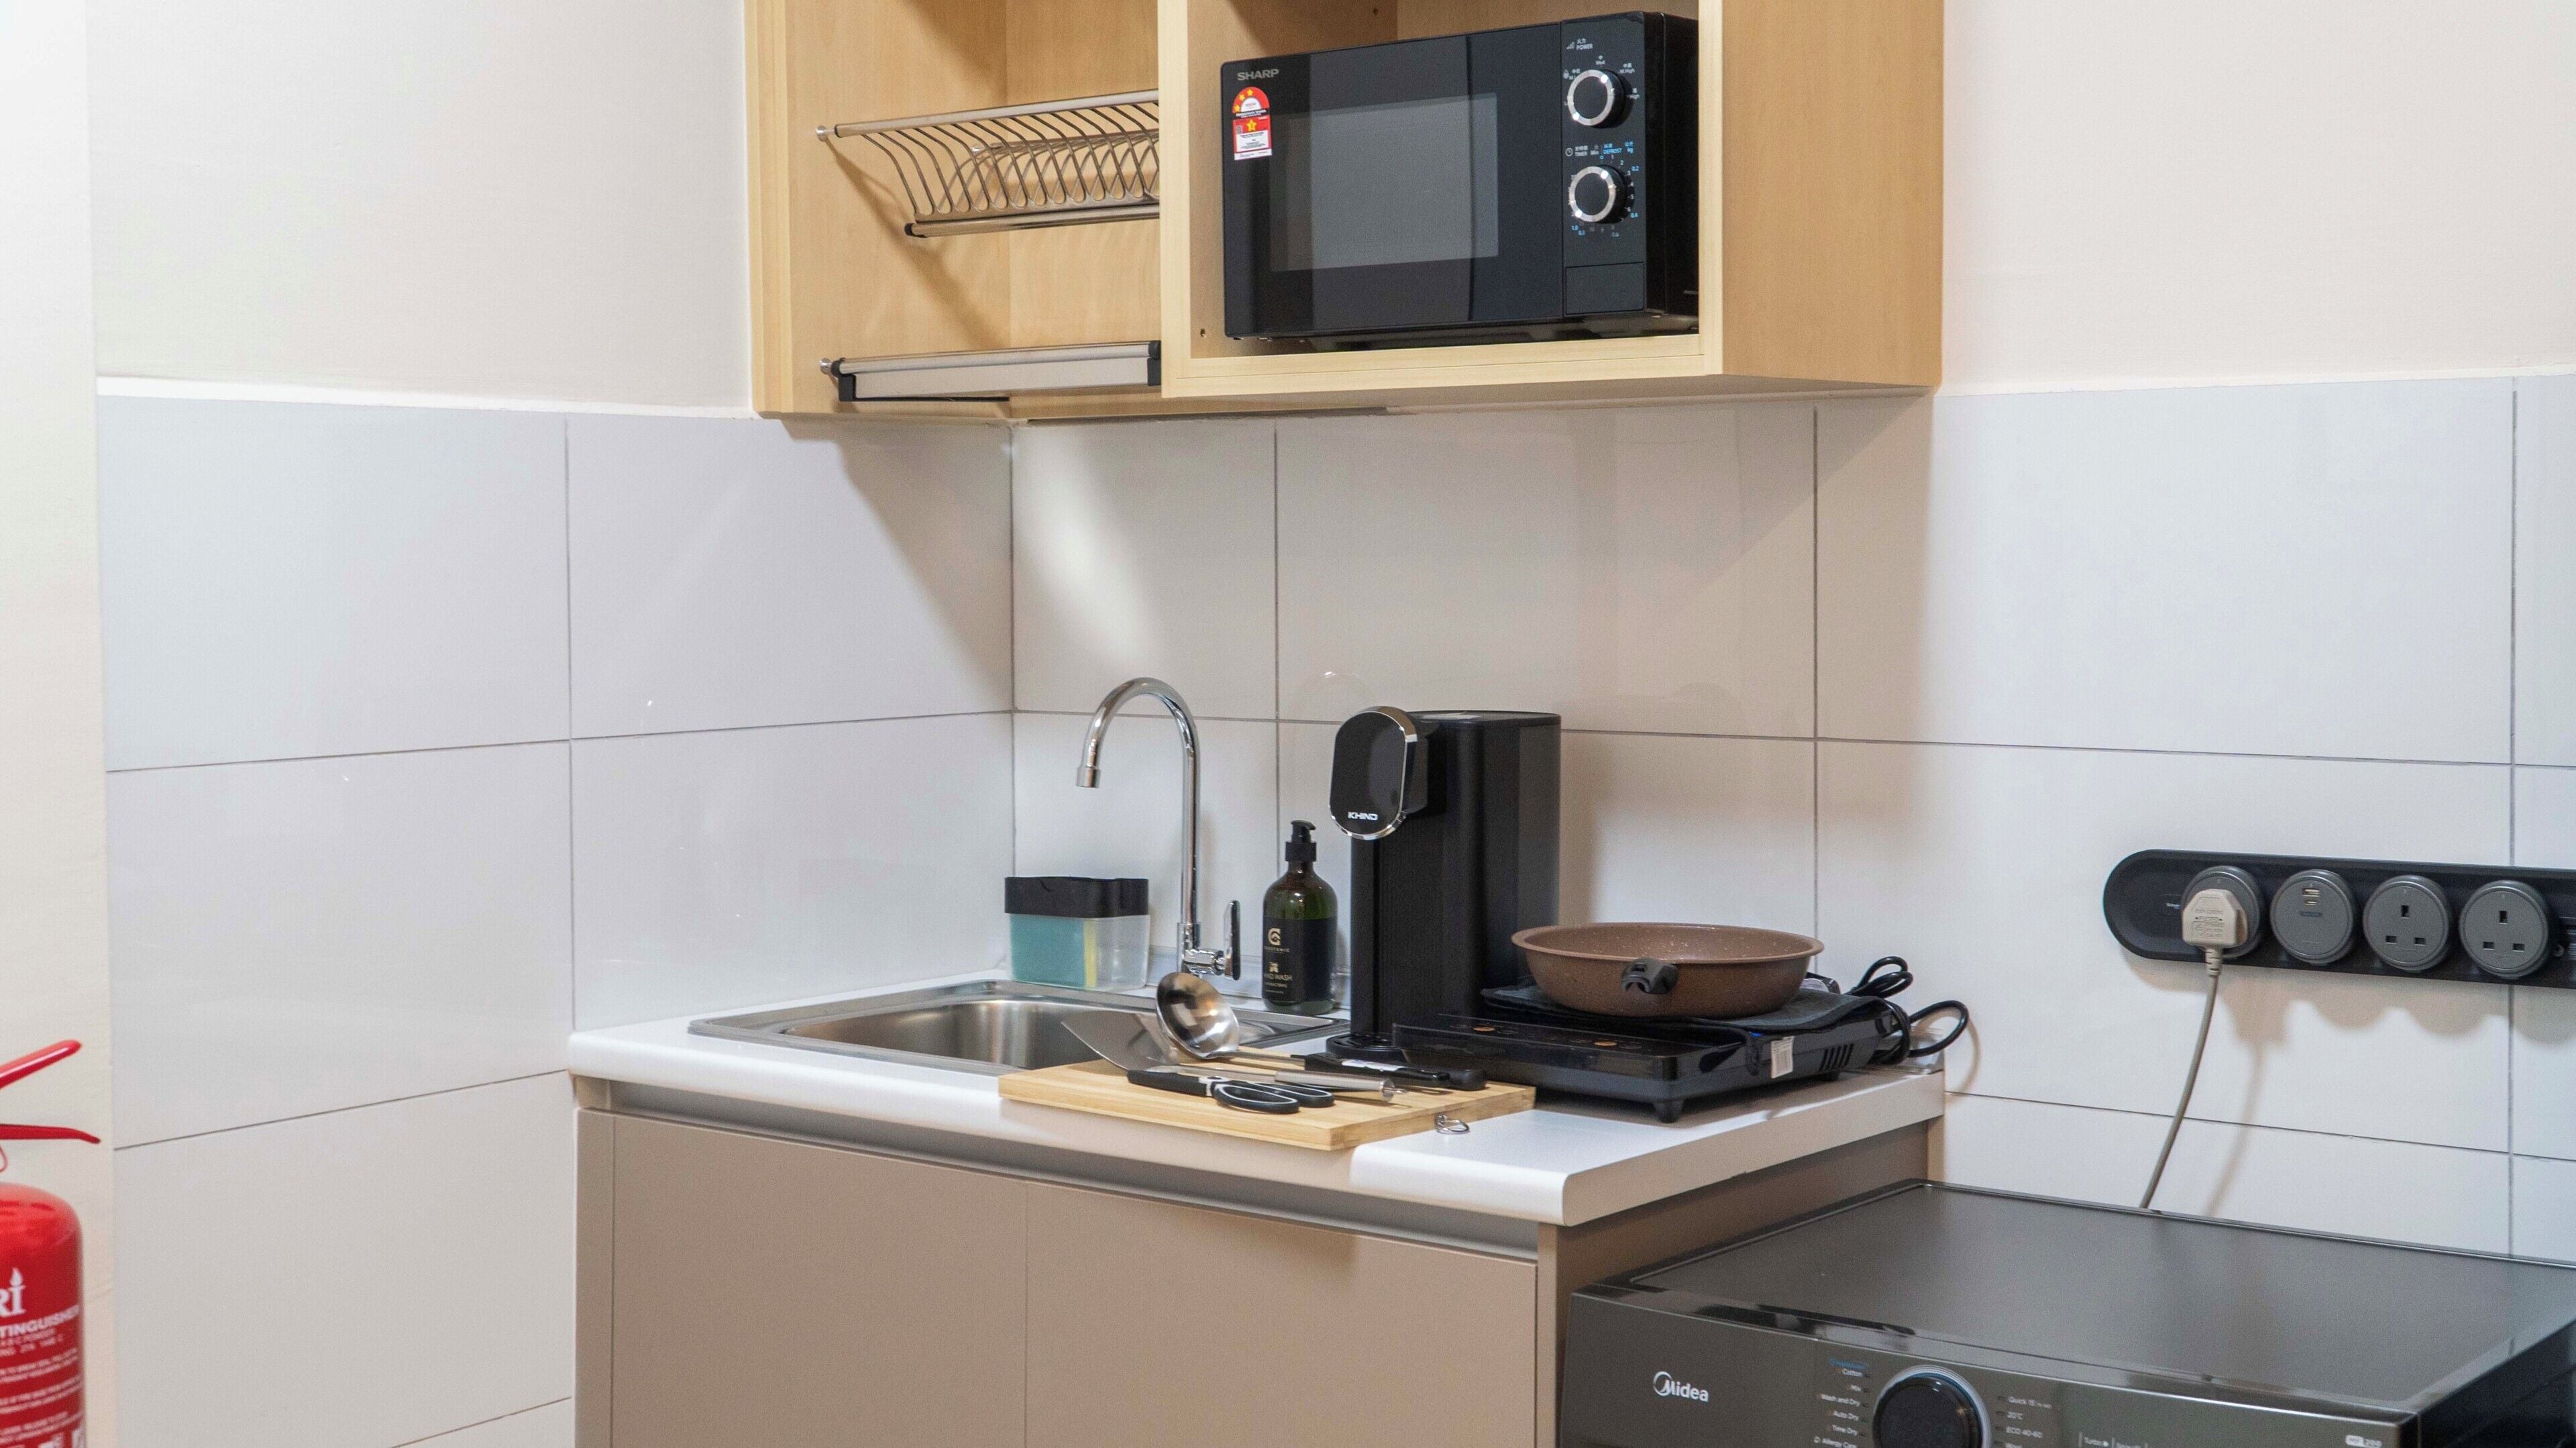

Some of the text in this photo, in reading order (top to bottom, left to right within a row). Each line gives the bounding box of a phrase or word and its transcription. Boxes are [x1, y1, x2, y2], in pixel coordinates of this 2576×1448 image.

[1237, 68, 1279, 81] SHARP
[1348, 811, 1379, 821] KHIND
[1653, 1371, 1709, 1402] Midea
[1833, 1410, 1859, 1421] Auto Dry
[2006, 1427, 2021, 1435] ECO
